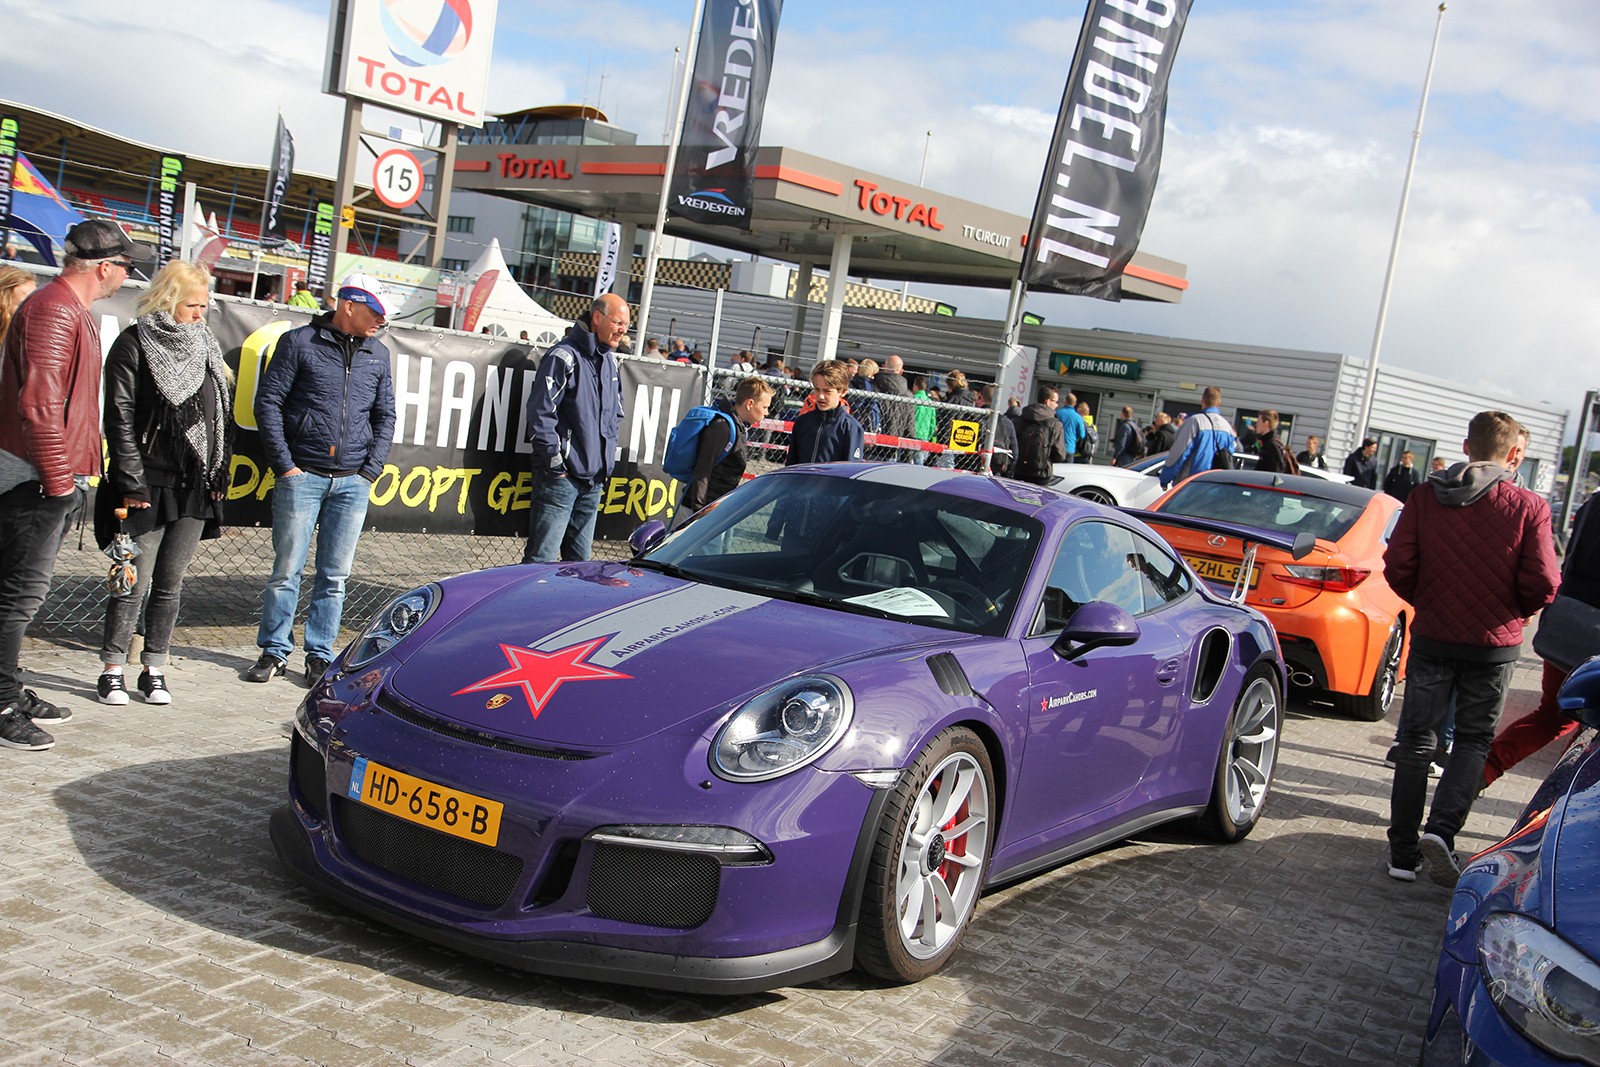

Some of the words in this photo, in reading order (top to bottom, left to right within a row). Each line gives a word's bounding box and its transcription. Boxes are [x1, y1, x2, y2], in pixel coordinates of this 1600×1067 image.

[358, 56, 475, 116] TOTAL
[705, 0, 757, 170] VREDE
[384, 165, 412, 192] 15
[497, 153, 571, 180] TOTAL
[677, 195, 746, 216] VREDESTEIN
[854, 179, 944, 231] TOTAL
[962, 225, 975, 239] TT
[975, 228, 1012, 248] CIRCUIT
[369, 464, 482, 514] OOPT
[1187, 559, 1248, 582] -ZHL-8
[350, 781, 361, 794] NL
[369, 771, 489, 836] HD-658-B
